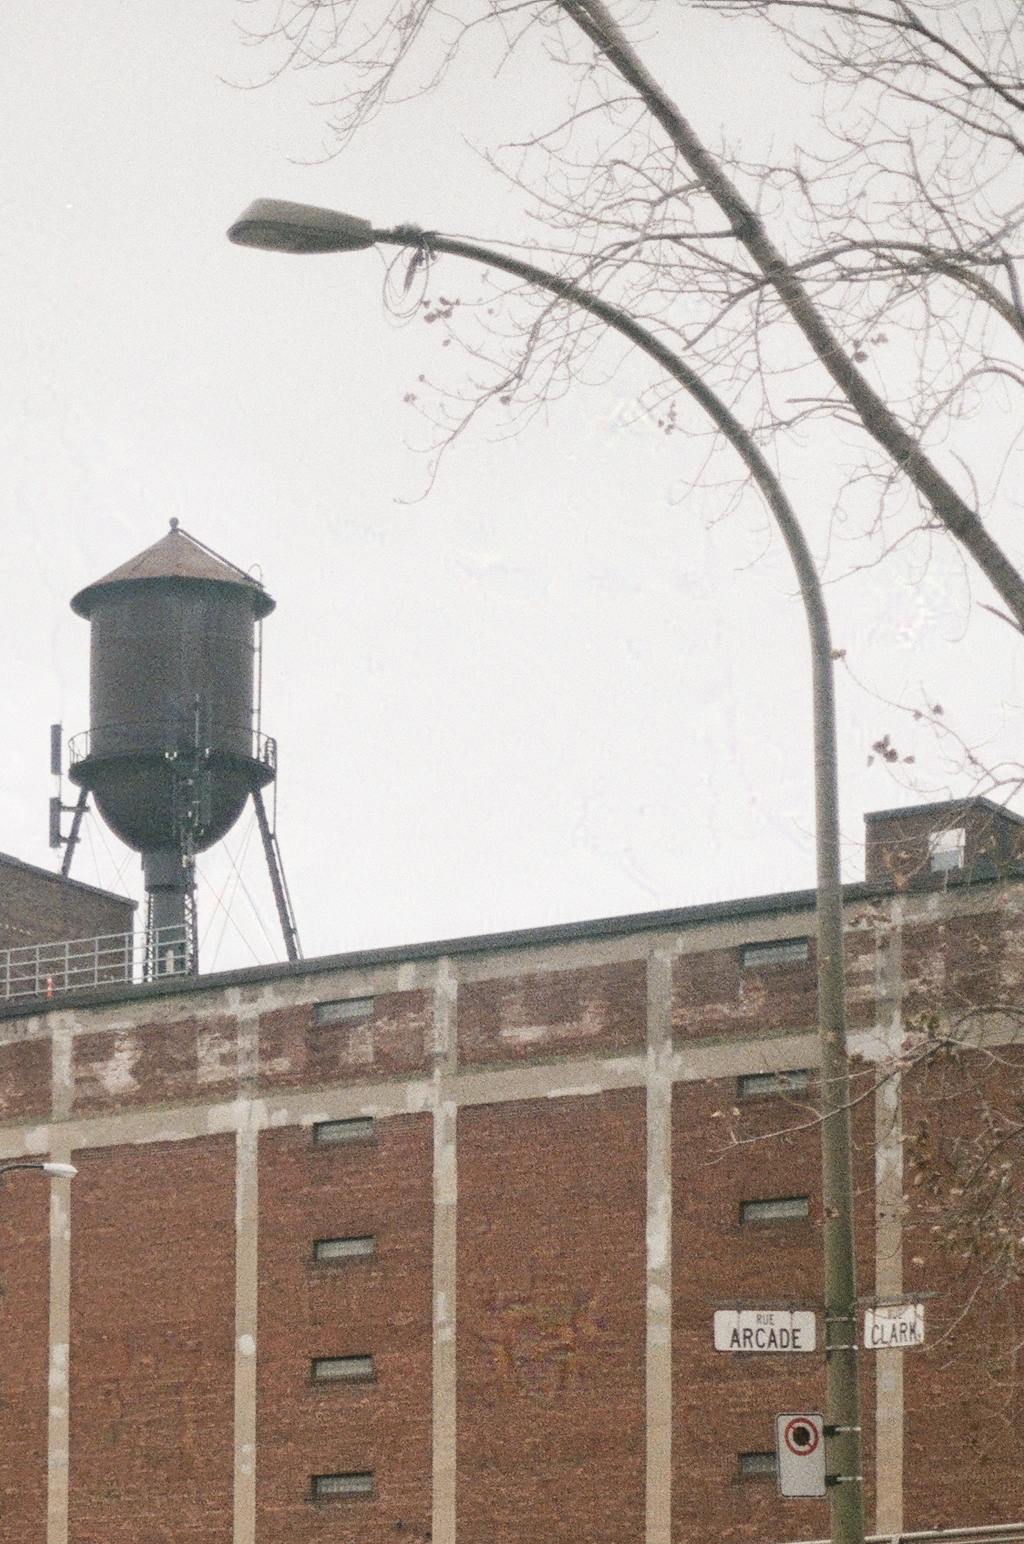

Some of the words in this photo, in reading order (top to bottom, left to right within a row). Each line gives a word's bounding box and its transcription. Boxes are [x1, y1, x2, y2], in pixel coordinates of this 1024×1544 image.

[756, 1313, 775, 1325] RUE
[888, 1309, 903, 1320] RUE
[730, 1328, 802, 1349] ARCADE
[871, 1323, 918, 1346] CLARK
